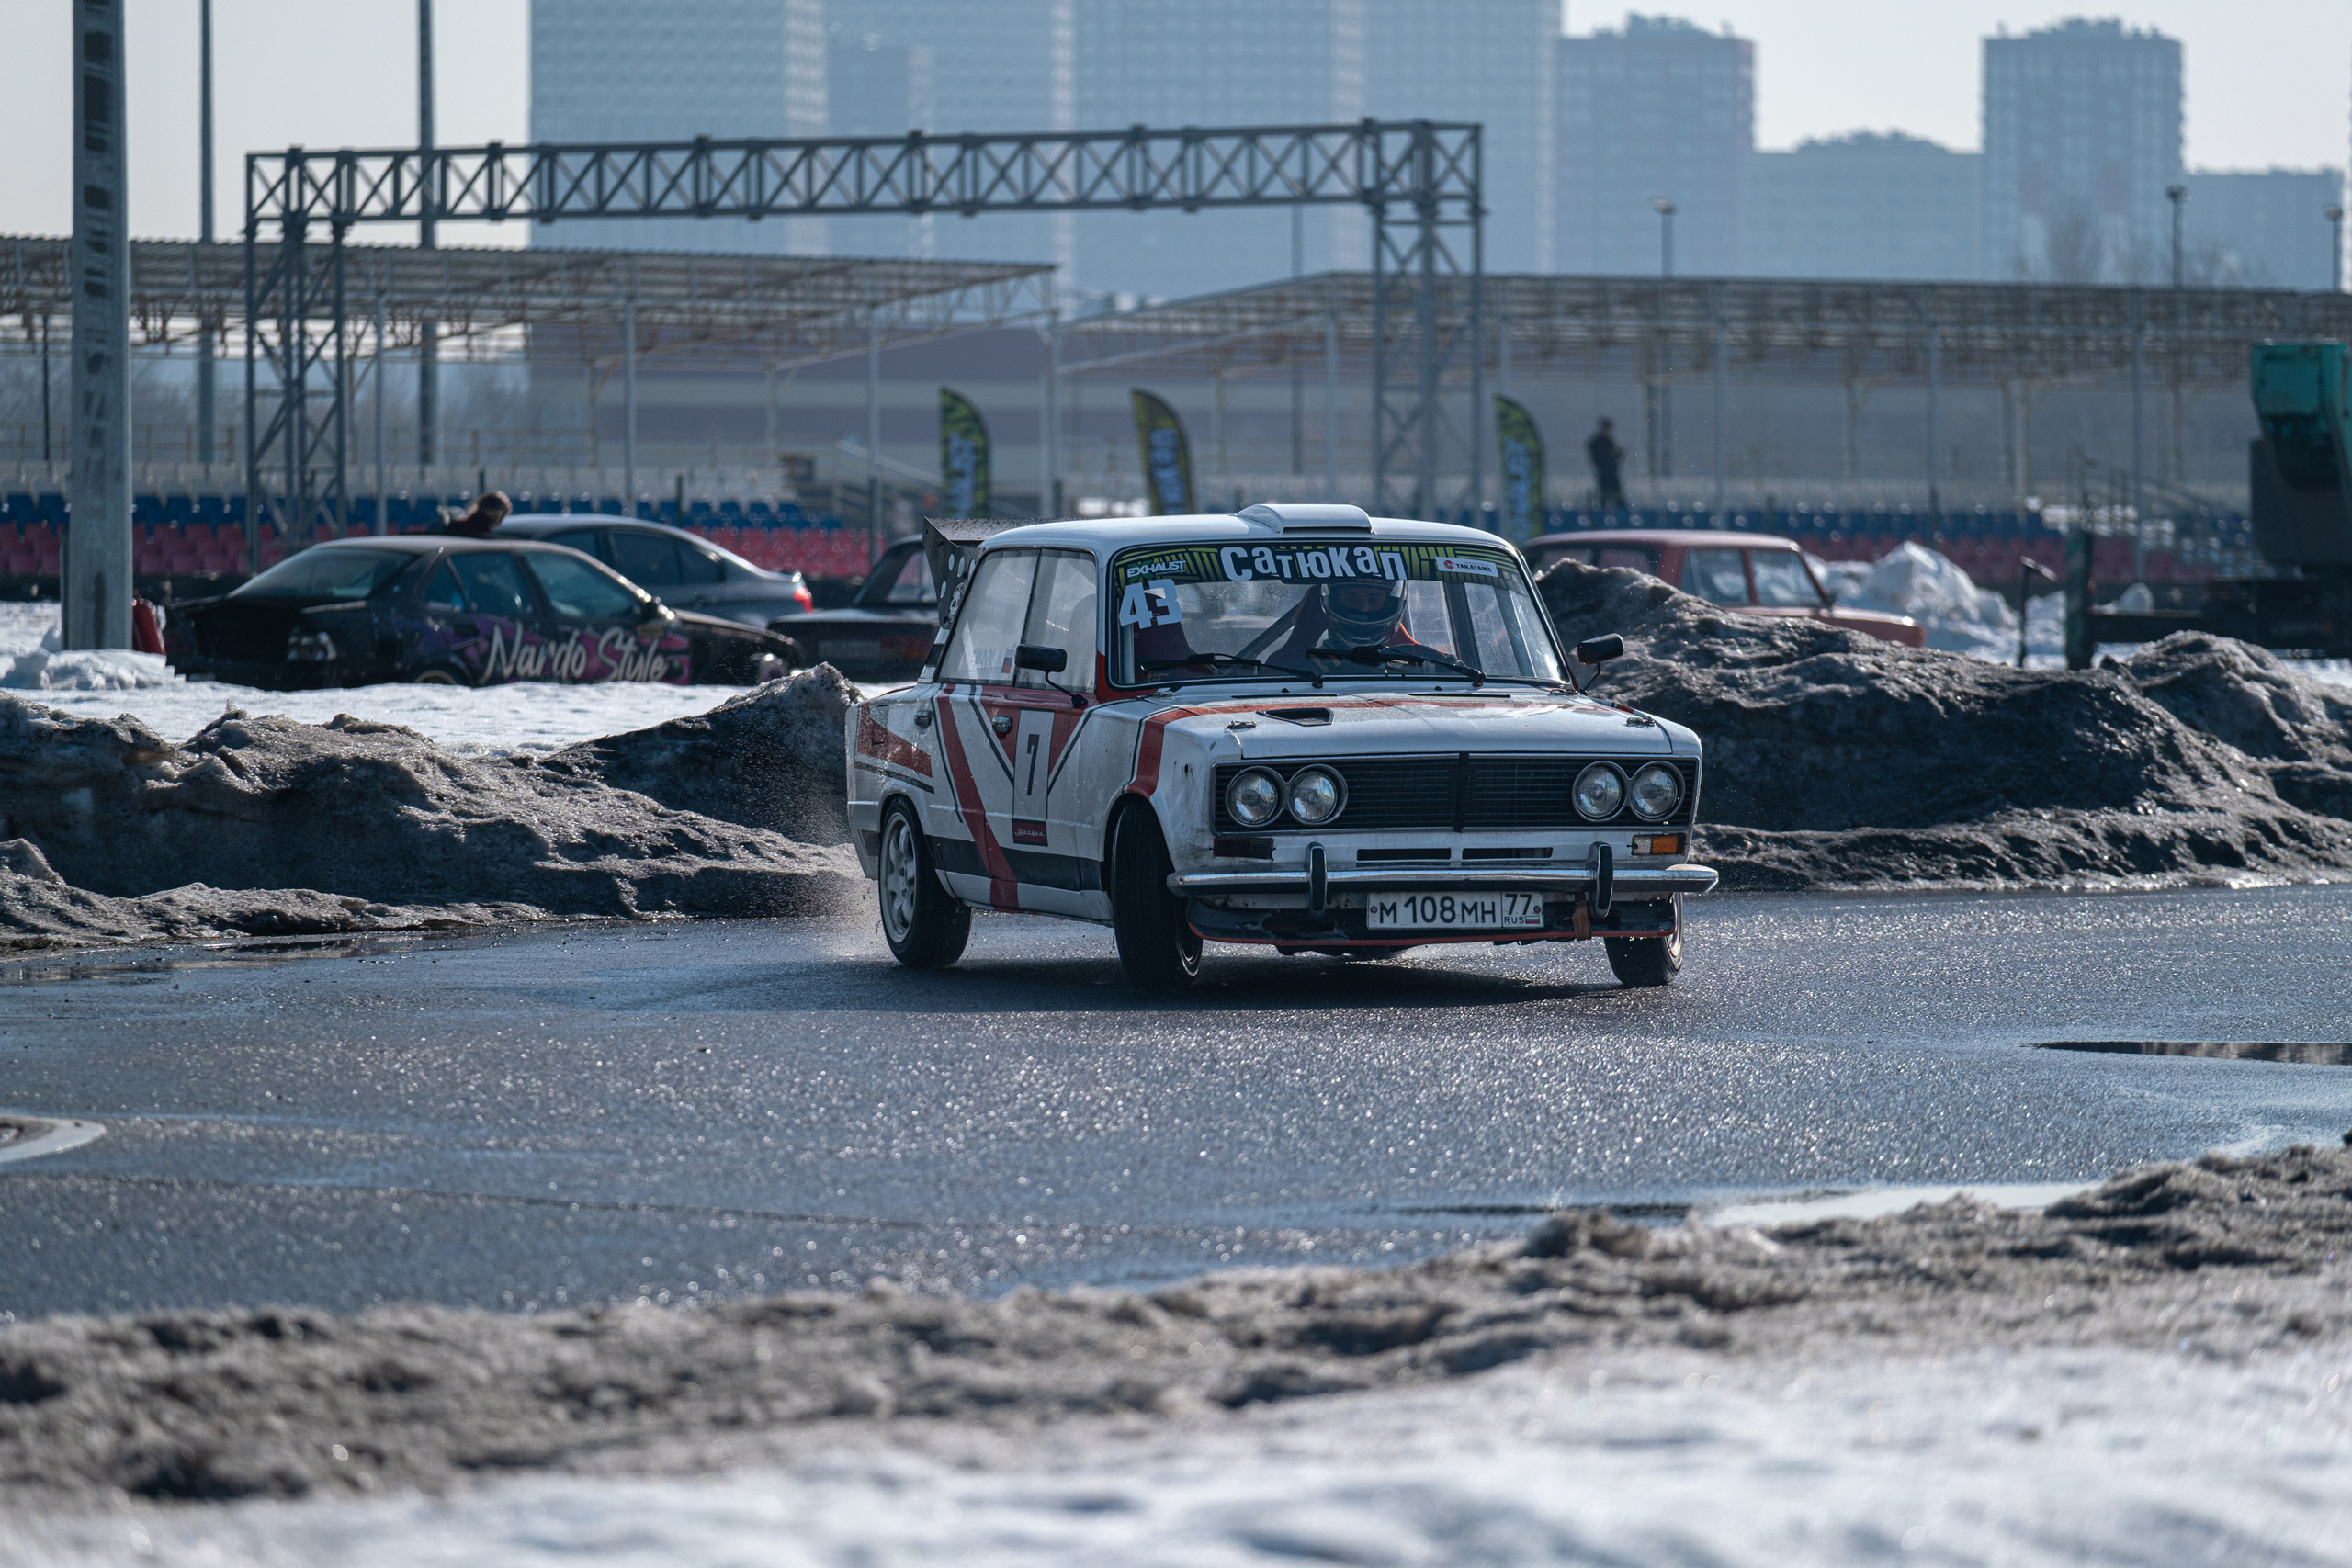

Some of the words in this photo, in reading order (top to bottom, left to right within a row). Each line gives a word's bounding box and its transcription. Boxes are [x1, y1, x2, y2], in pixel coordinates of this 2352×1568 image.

[1126, 560, 1187, 579] EXHAUST
[1455, 563, 1492, 573] TAKAYAMA
[1119, 578, 1182, 629] 43
[478, 619, 587, 685] Nardo
[597, 626, 669, 683] Style
[1505, 894, 1532, 916] 77
[1504, 916, 1524, 924] RUS
